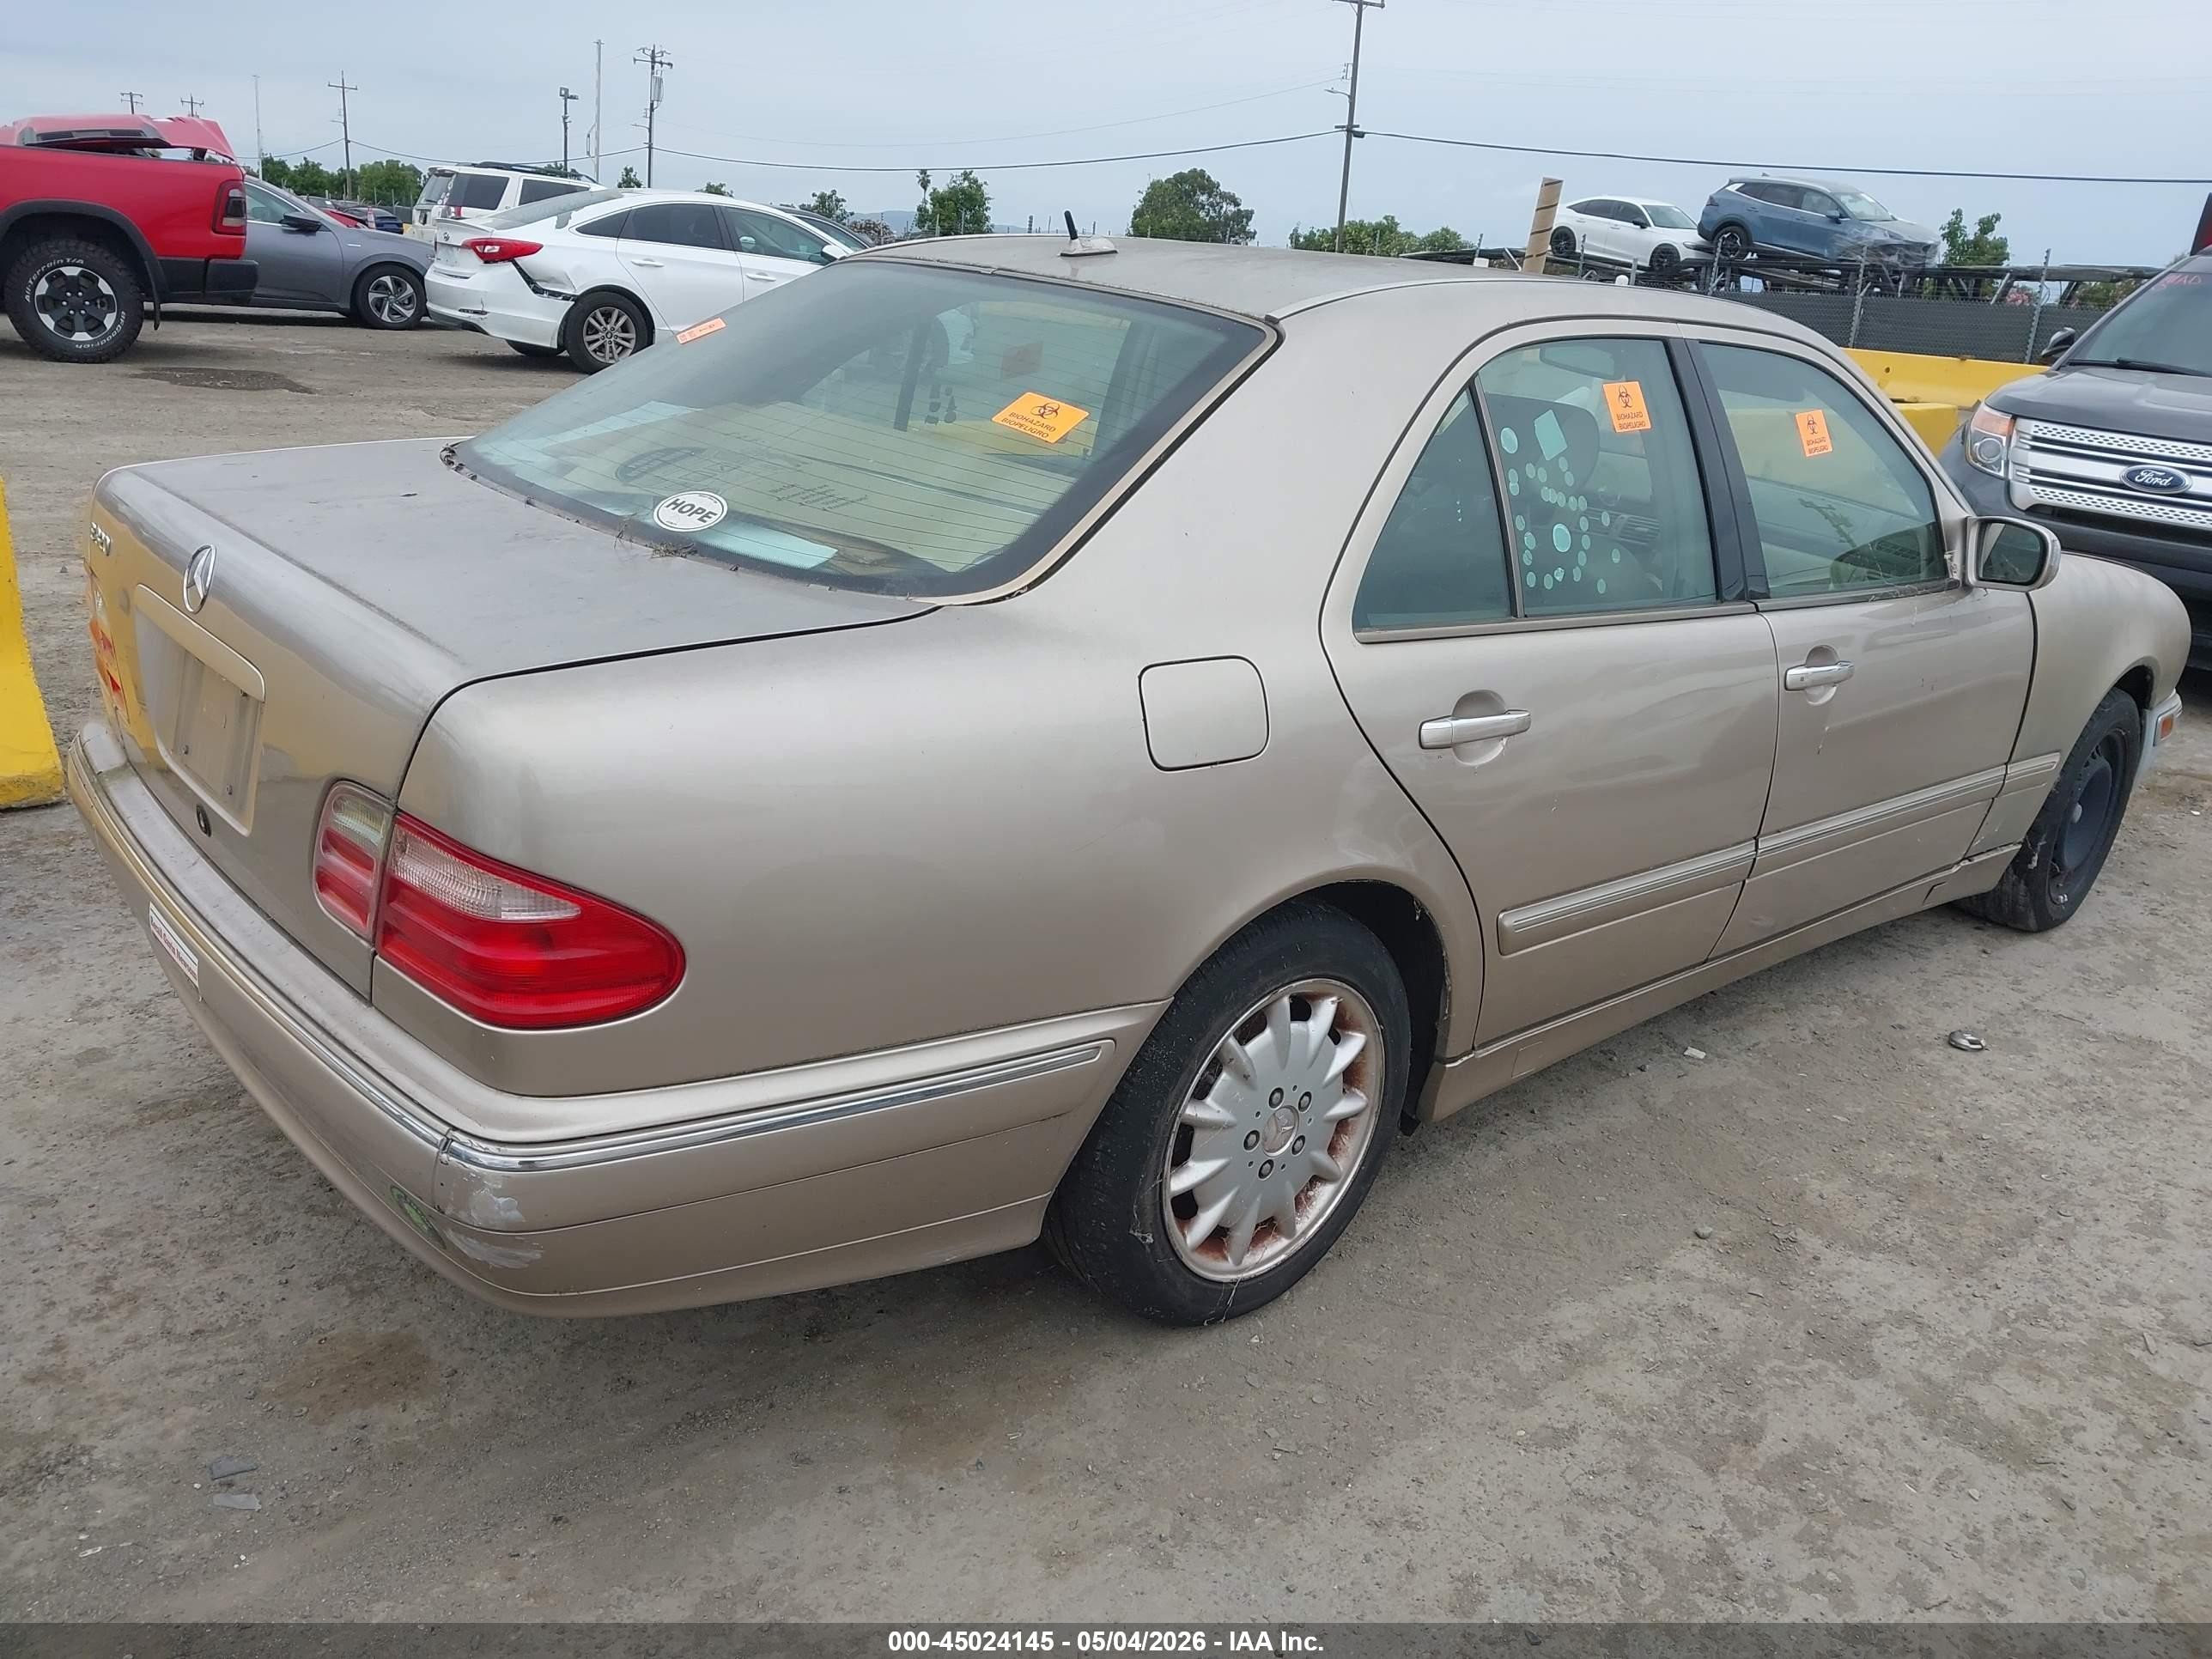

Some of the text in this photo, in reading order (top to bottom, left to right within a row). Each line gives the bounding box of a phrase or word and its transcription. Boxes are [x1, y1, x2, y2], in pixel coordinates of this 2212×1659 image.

[1001, 416, 1049, 439] BIOPELIGRO
[1008, 411, 1056, 433] BIOHAZARD
[2135, 469, 2174, 486] Ford
[665, 498, 718, 523] HOPE
